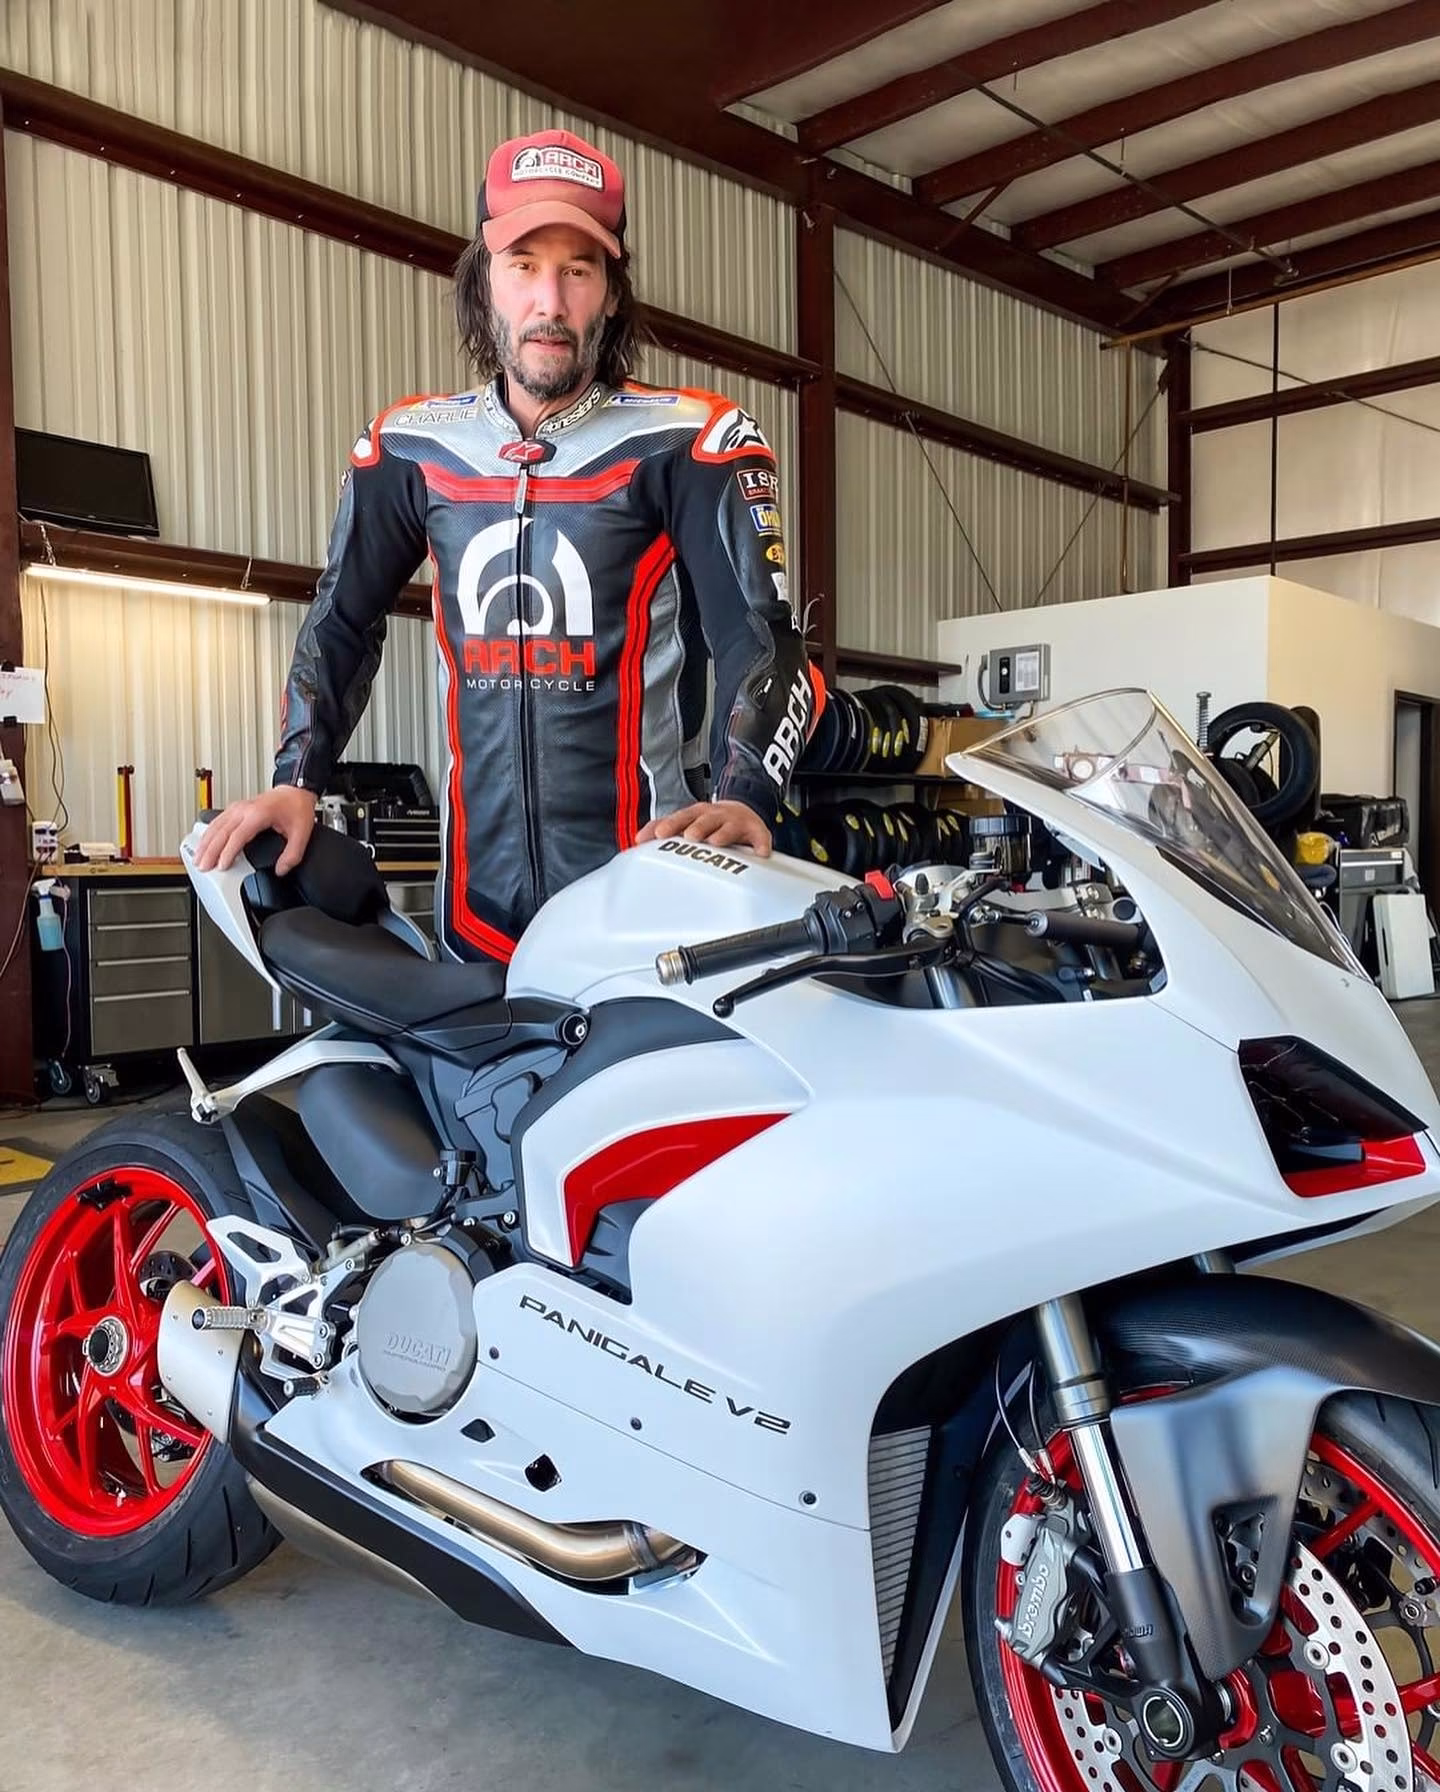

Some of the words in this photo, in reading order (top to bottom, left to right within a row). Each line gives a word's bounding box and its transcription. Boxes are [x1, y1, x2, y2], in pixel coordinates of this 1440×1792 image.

[543, 150, 599, 178] ARCH
[394, 407, 479, 427] CHARLIE
[542, 386, 601, 433] alpinestars
[463, 639, 597, 676] ARCH
[466, 679, 596, 692] MOTORCYCLE
[762, 668, 812, 787] ARCH
[658, 841, 750, 875] DUCATI
[385, 1332, 452, 1366] DUCATI
[519, 1295, 716, 1404] PANIGALE
[726, 1396, 791, 1435] V2
[1018, 1564, 1049, 1639] brembo
